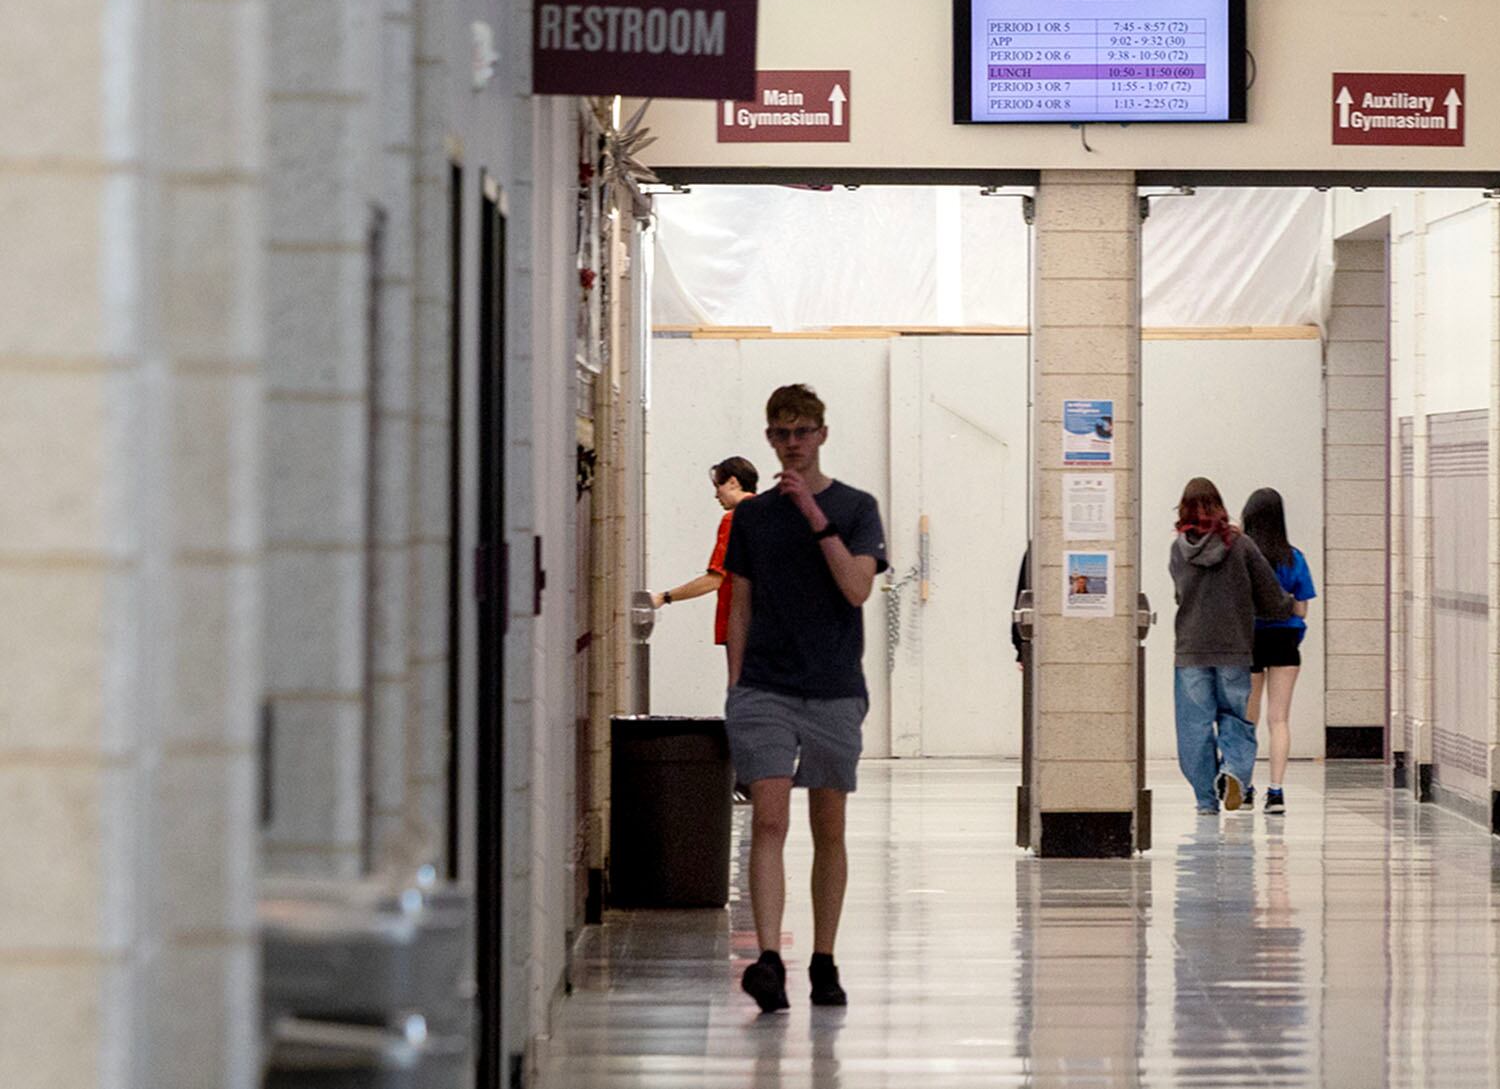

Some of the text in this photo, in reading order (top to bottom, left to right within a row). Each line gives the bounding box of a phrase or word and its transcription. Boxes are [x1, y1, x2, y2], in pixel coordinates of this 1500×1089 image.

[539, 4, 726, 57] RESTROOM
[990, 22, 1071, 32] PERIOD 1 OR 5
[1113, 22, 1135, 32] 7:45
[1144, 22, 1166, 32] 8:57
[1168, 22, 1189, 34] (72)
[990, 37, 1013, 46] APP
[1110, 36, 1132, 46] 9:02
[1141, 36, 1163, 46] 9:32
[1165, 36, 1186, 48] (30)
[990, 51, 1071, 61] PERIOD 2 OR 6
[1108, 51, 1130, 60] 9:38
[1140, 51, 1166, 60] 10:50
[1168, 50, 1189, 61] (72)
[990, 68, 1031, 78] LUNCH
[1109, 67, 1135, 77] 10:50
[1145, 67, 1172, 77] 11:50
[1174, 67, 1195, 79] (60)
[990, 82, 1071, 92] PERIOD 3 OR 7
[1111, 81, 1138, 91] 11:55
[1148, 81, 1169, 91] 1:07
[1171, 81, 1192, 93] (72)
[763, 89, 804, 106] Main
[1362, 92, 1435, 112] Auxiliary
[990, 99, 1071, 109] PERIOD 4 OR 8
[1115, 99, 1135, 109] 1:13
[1144, 99, 1166, 109] 2:25
[1168, 99, 1189, 110] (72)
[737, 108, 830, 129] Gymnasium
[1350, 111, 1446, 132] Gymnasium
